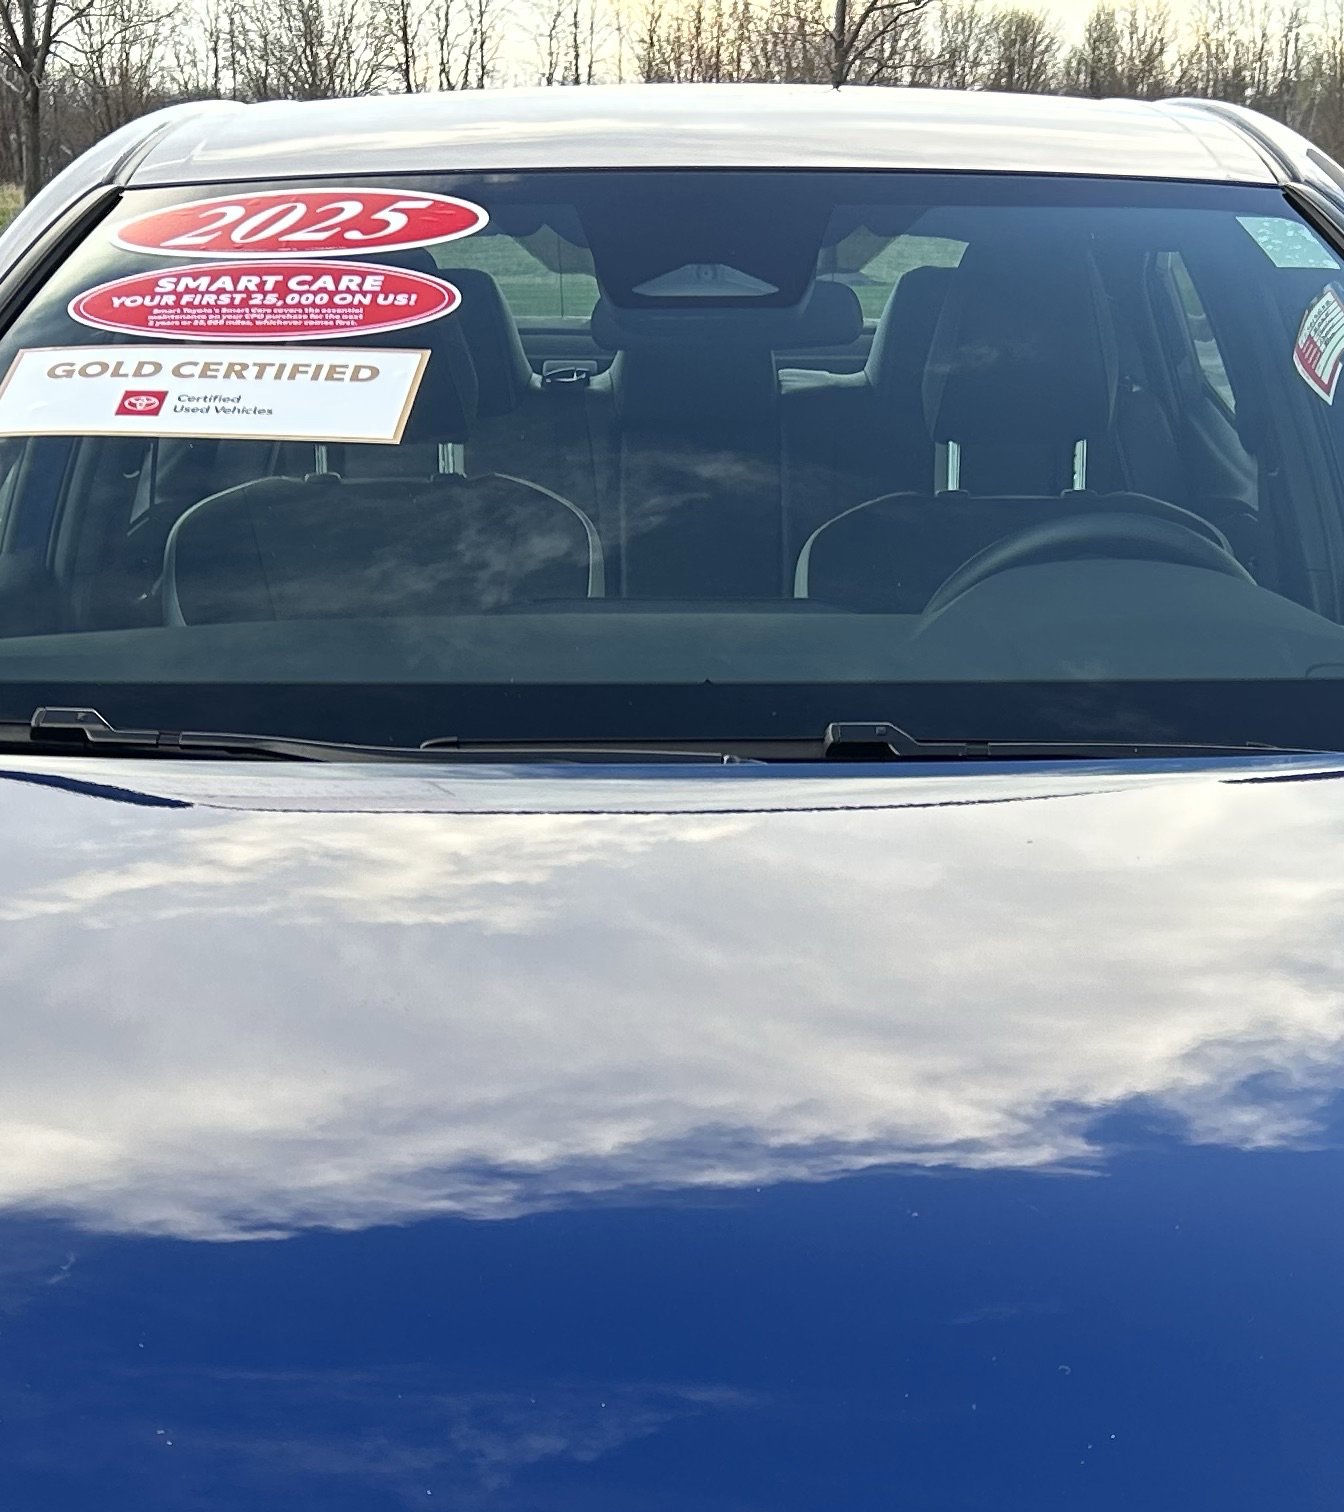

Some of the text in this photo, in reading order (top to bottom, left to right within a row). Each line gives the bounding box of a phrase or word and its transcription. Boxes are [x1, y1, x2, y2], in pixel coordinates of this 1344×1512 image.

[160, 201, 434, 247] 2025
[154, 275, 385, 293] SMART CARE
[111, 293, 418, 308] YOUR FIRST 25,000 ON US!
[46, 361, 381, 383] GOLD CERTIFIED
[177, 394, 241, 404] Certified
[173, 404, 274, 416] Used Vehicles
